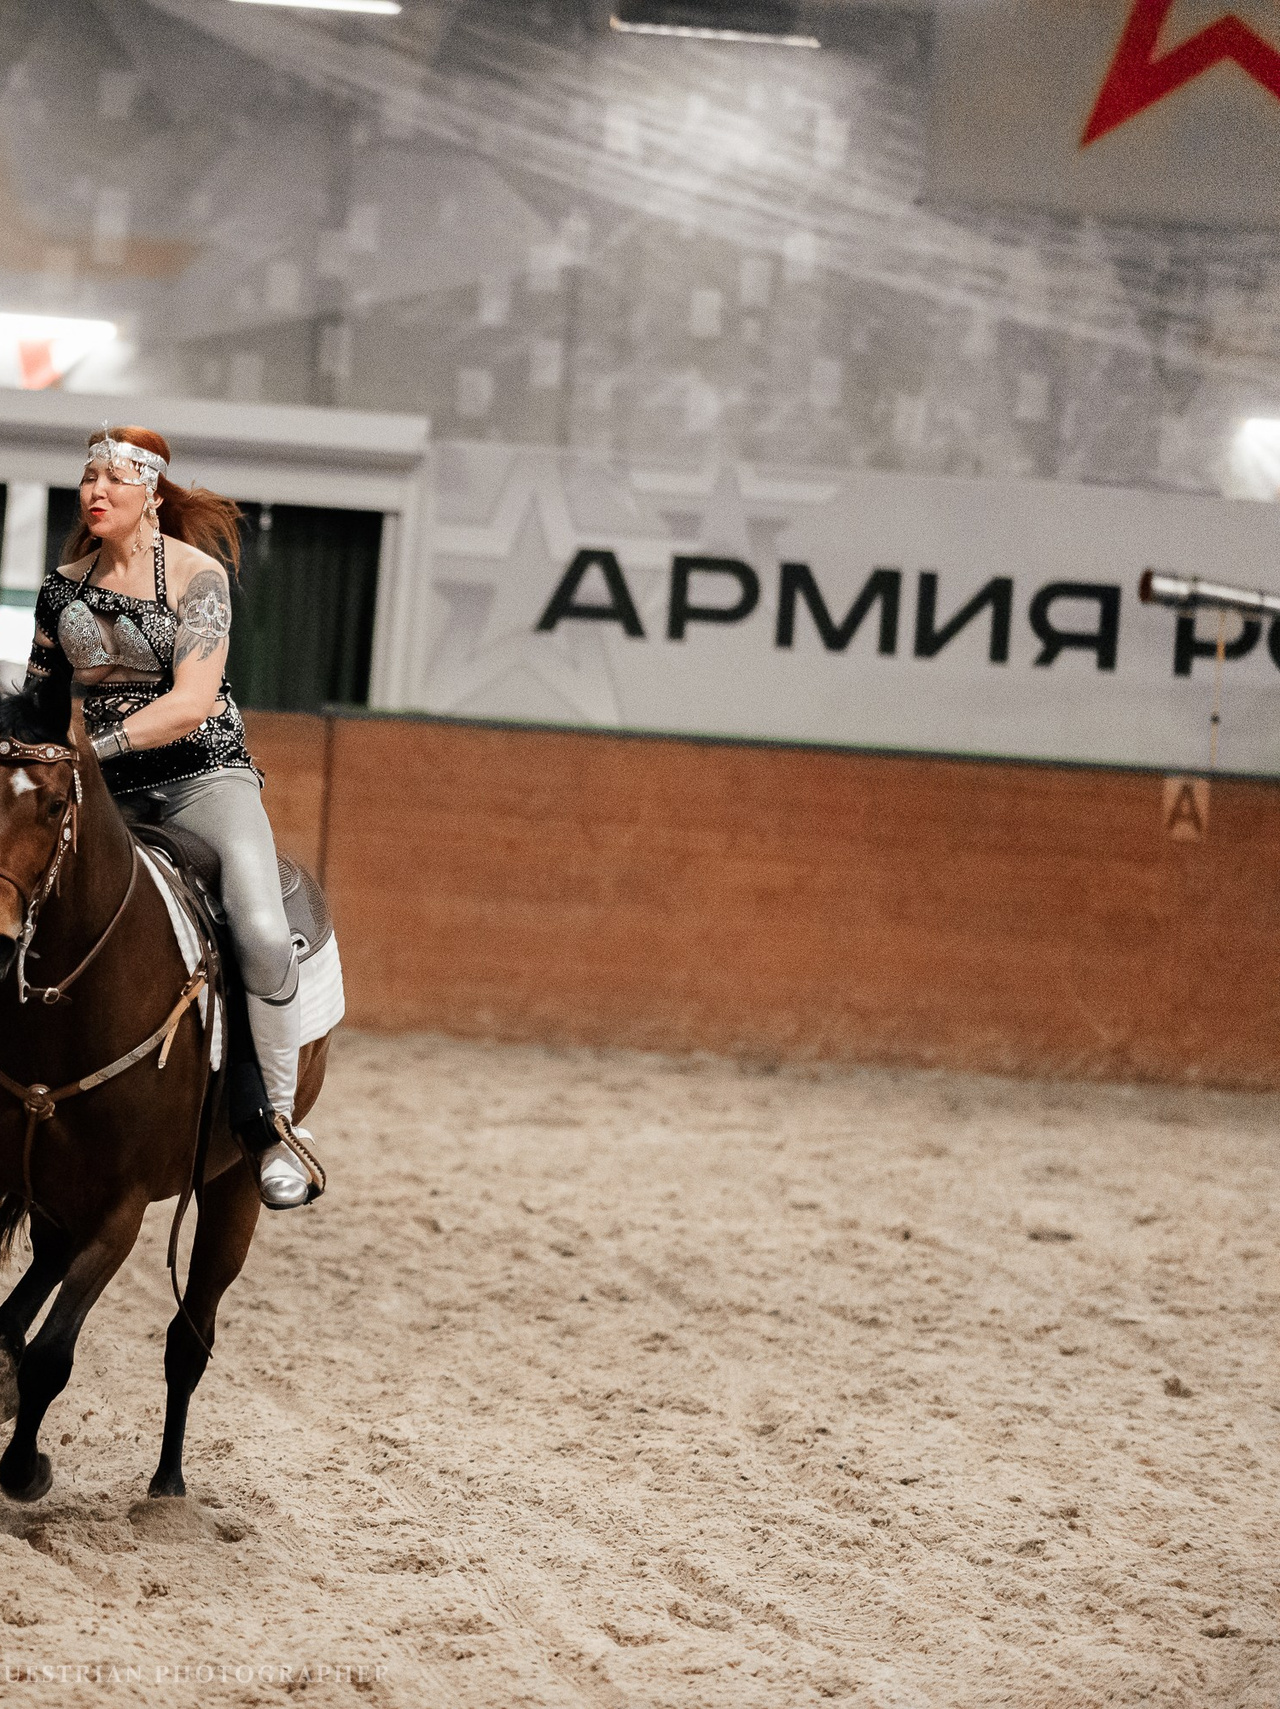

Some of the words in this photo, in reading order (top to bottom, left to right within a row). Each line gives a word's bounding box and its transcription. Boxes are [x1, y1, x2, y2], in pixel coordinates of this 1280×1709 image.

[534, 546, 1122, 673] АРМИЯ
[1173, 594, 1280, 677] Р
[1166, 783, 1203, 834] A
